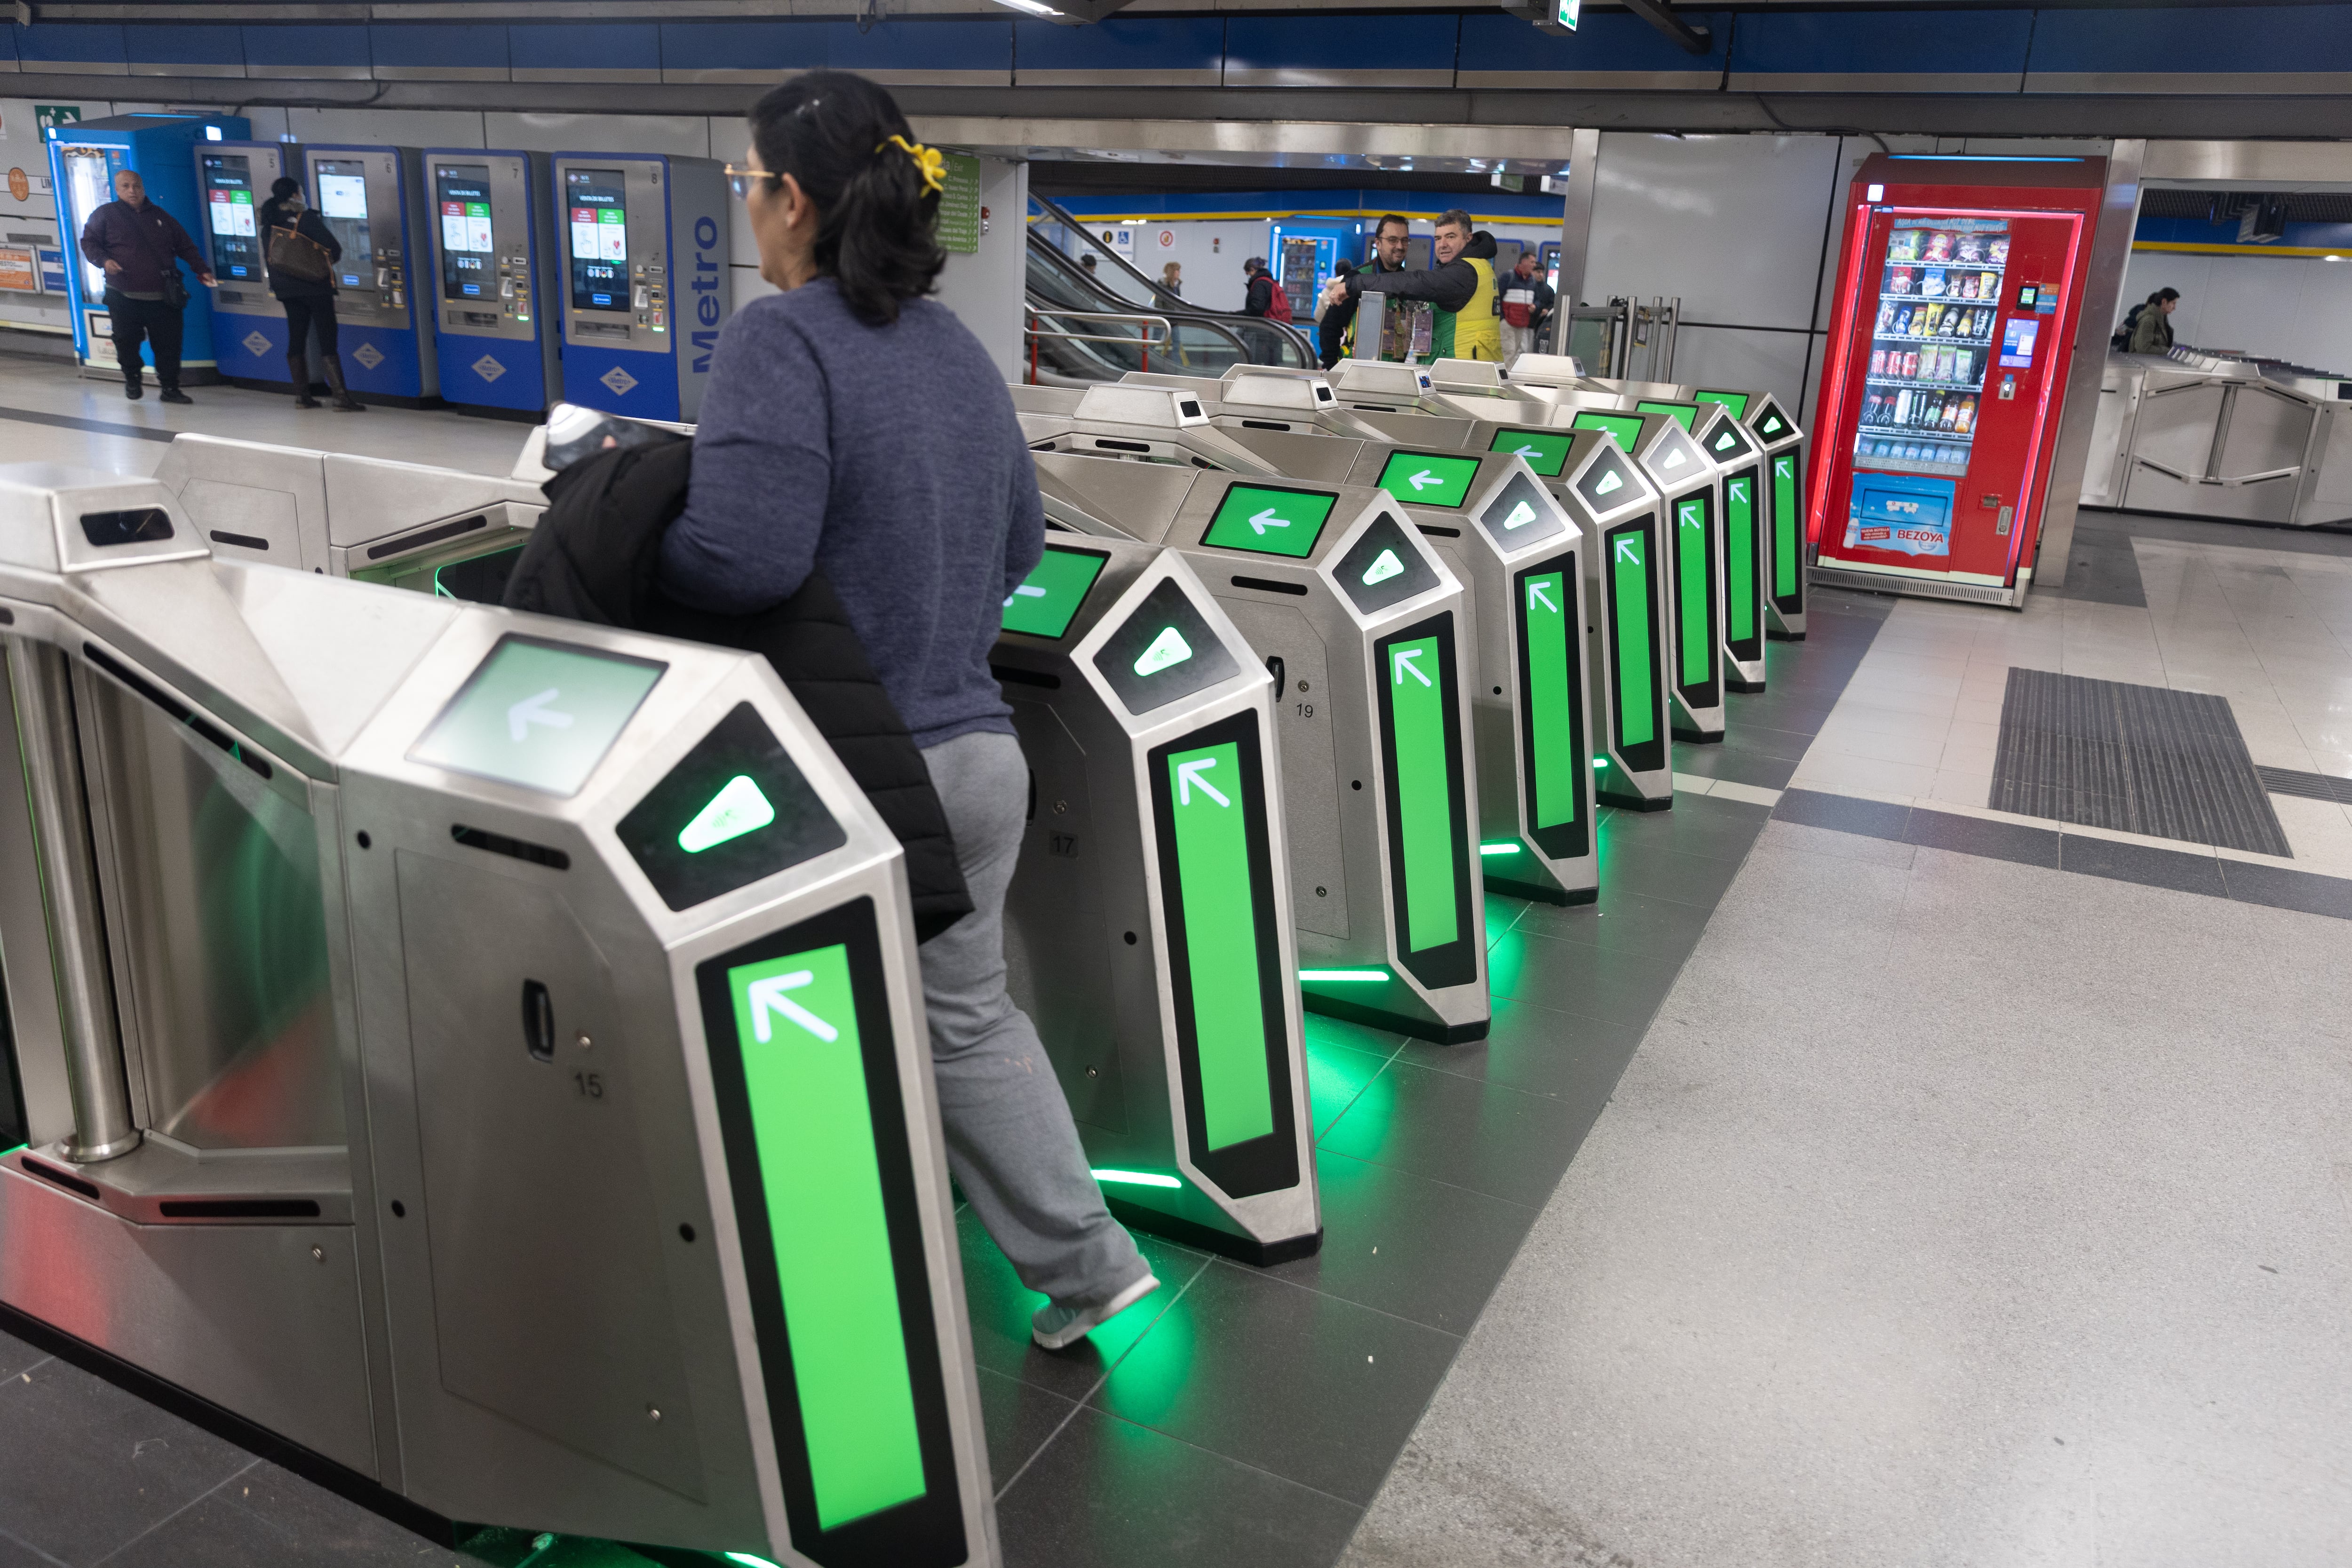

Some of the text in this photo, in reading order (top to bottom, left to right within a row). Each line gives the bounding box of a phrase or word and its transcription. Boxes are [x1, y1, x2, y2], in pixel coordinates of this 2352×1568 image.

[386, 164, 391, 173] 6
[512, 168, 518, 178] 7
[651, 174, 657, 184] 8
[691, 216, 721, 373] Metro
[611, 376, 629, 384] Metro
[1898, 530, 1943, 543] BEZOYA
[1296, 703, 1313, 718] 19
[1054, 835, 1074, 854] 17
[575, 1071, 603, 1098] 15
